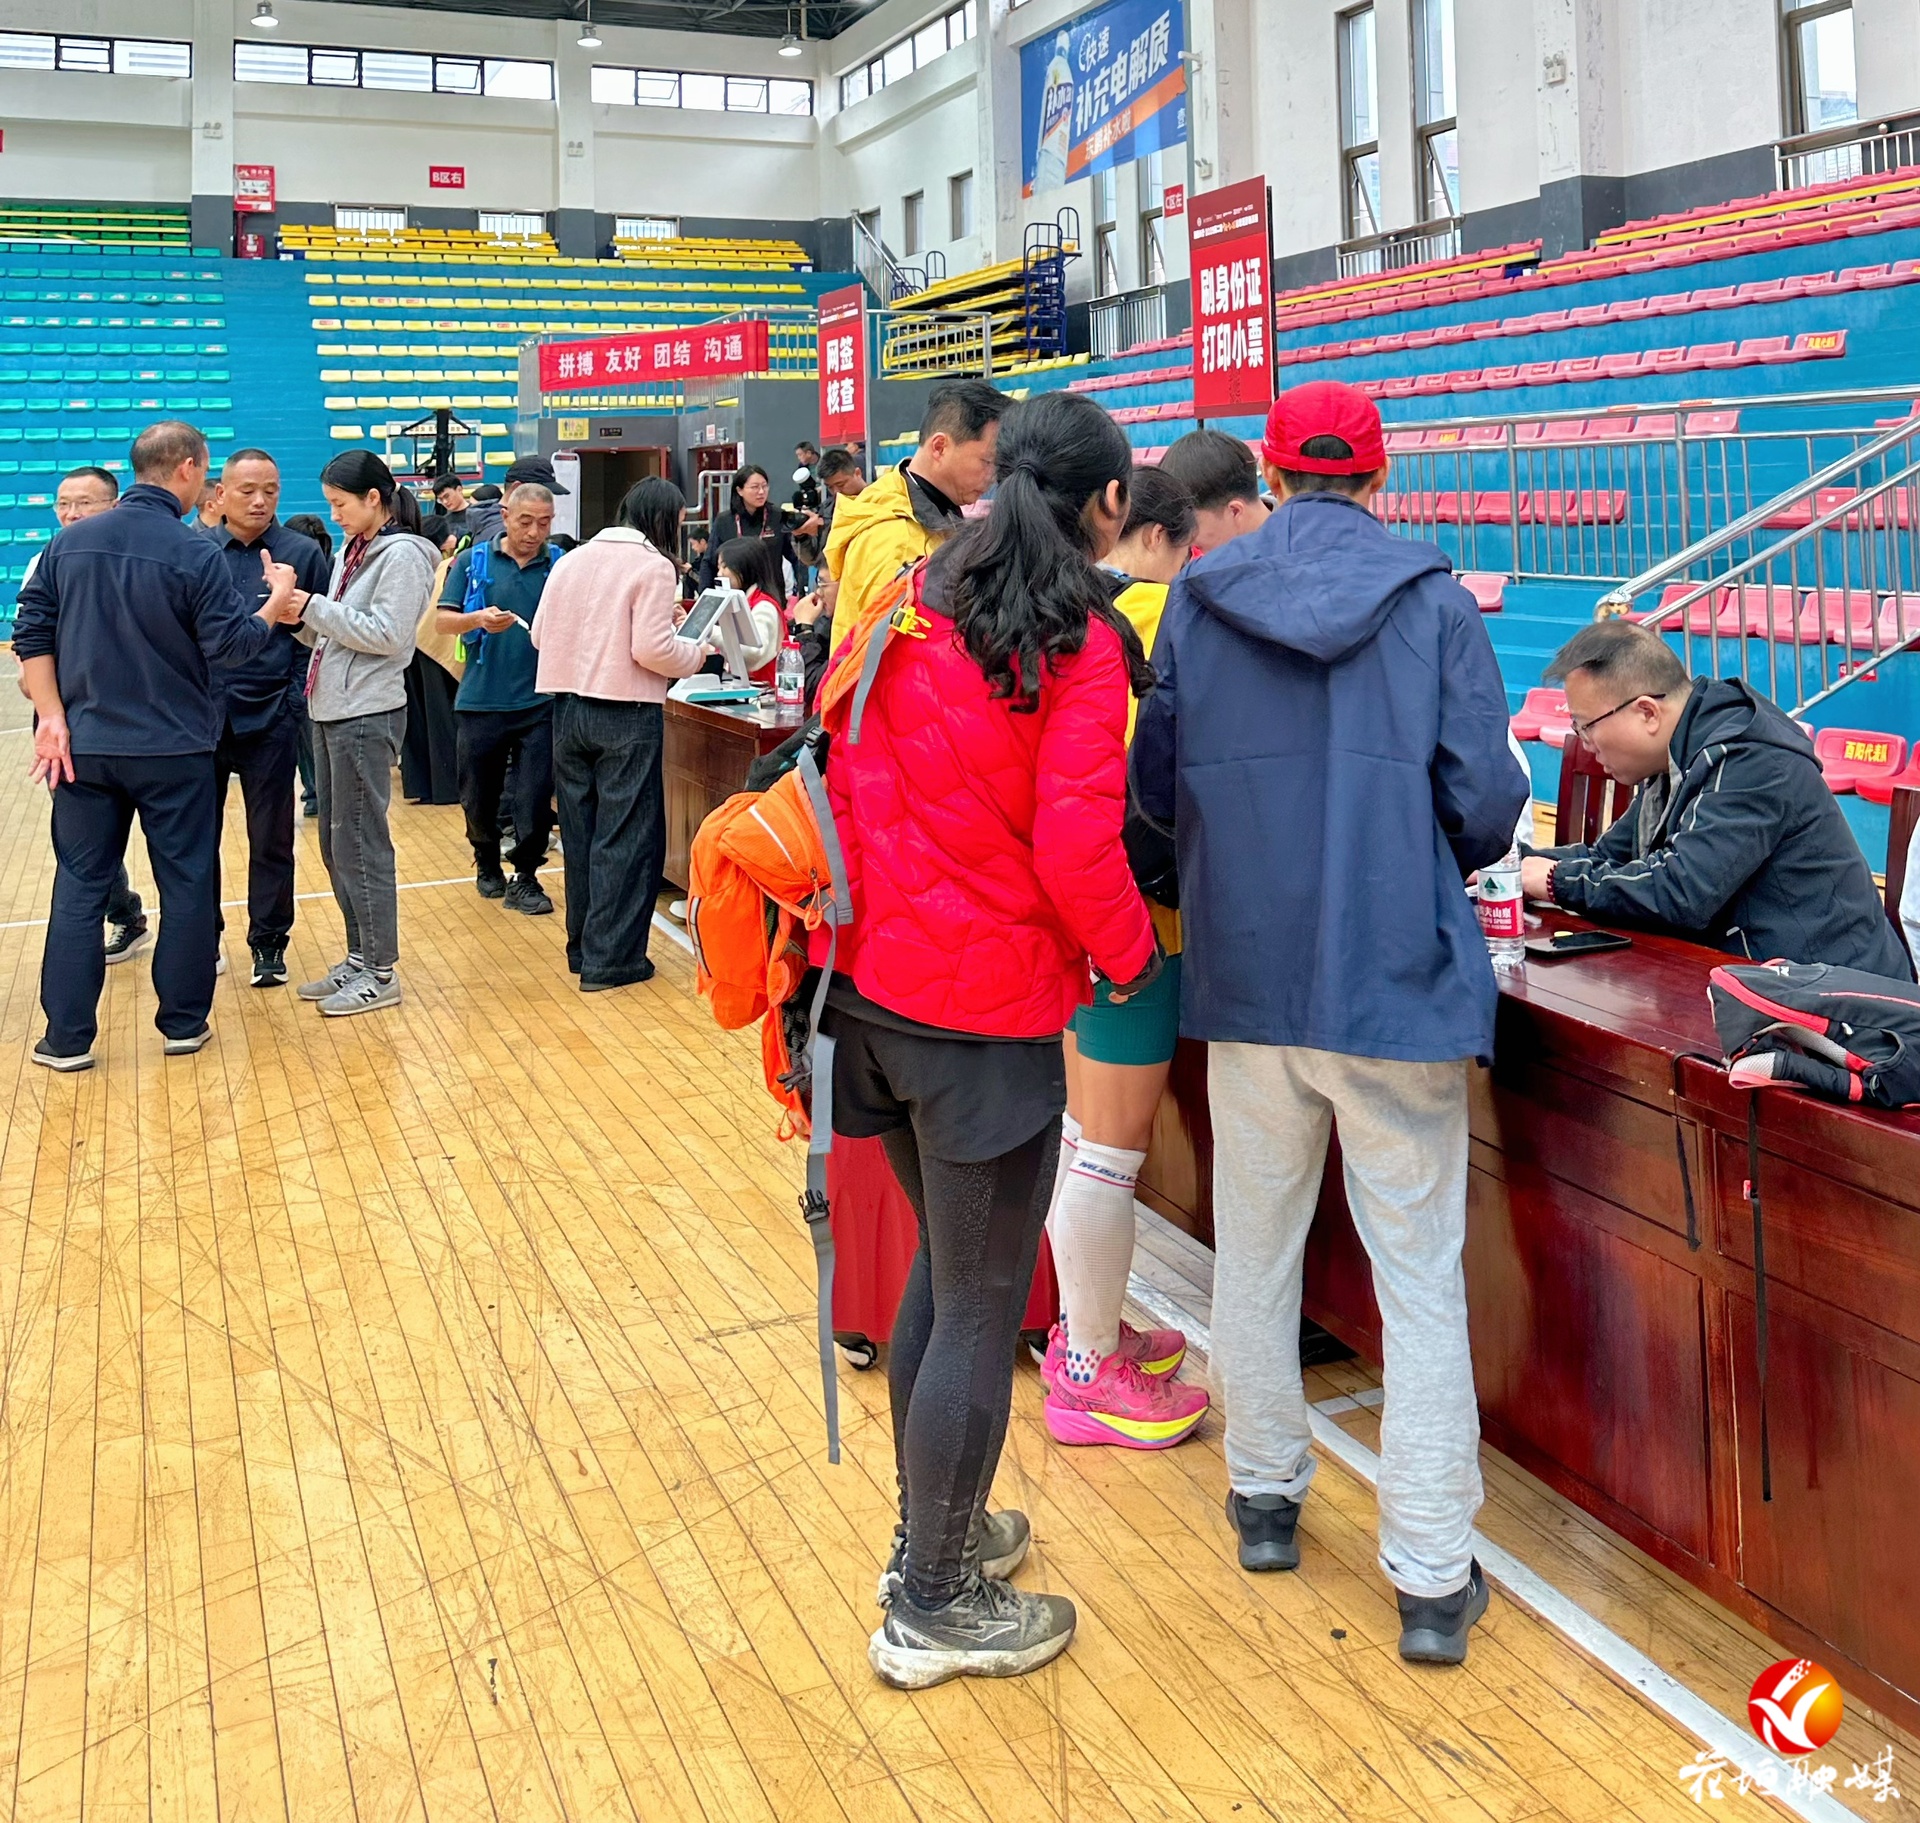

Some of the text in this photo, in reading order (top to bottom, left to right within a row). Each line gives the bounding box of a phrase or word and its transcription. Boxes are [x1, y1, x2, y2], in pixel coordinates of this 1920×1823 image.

[1086, 25, 1110, 73] 快速
[1075, 9, 1171, 137] 补充电解质
[432, 171, 462, 184] B区右
[1165, 192, 1183, 210] C区左
[1200, 257, 1263, 316] 刷身份证
[558, 333, 744, 380] 拼搏 友好 团结 沟通
[825, 334, 855, 376] 网签
[1202, 317, 1264, 374] 打印小票
[826, 376, 855, 415] 核查
[1844, 740, 1889, 763] 酉阳代表队
